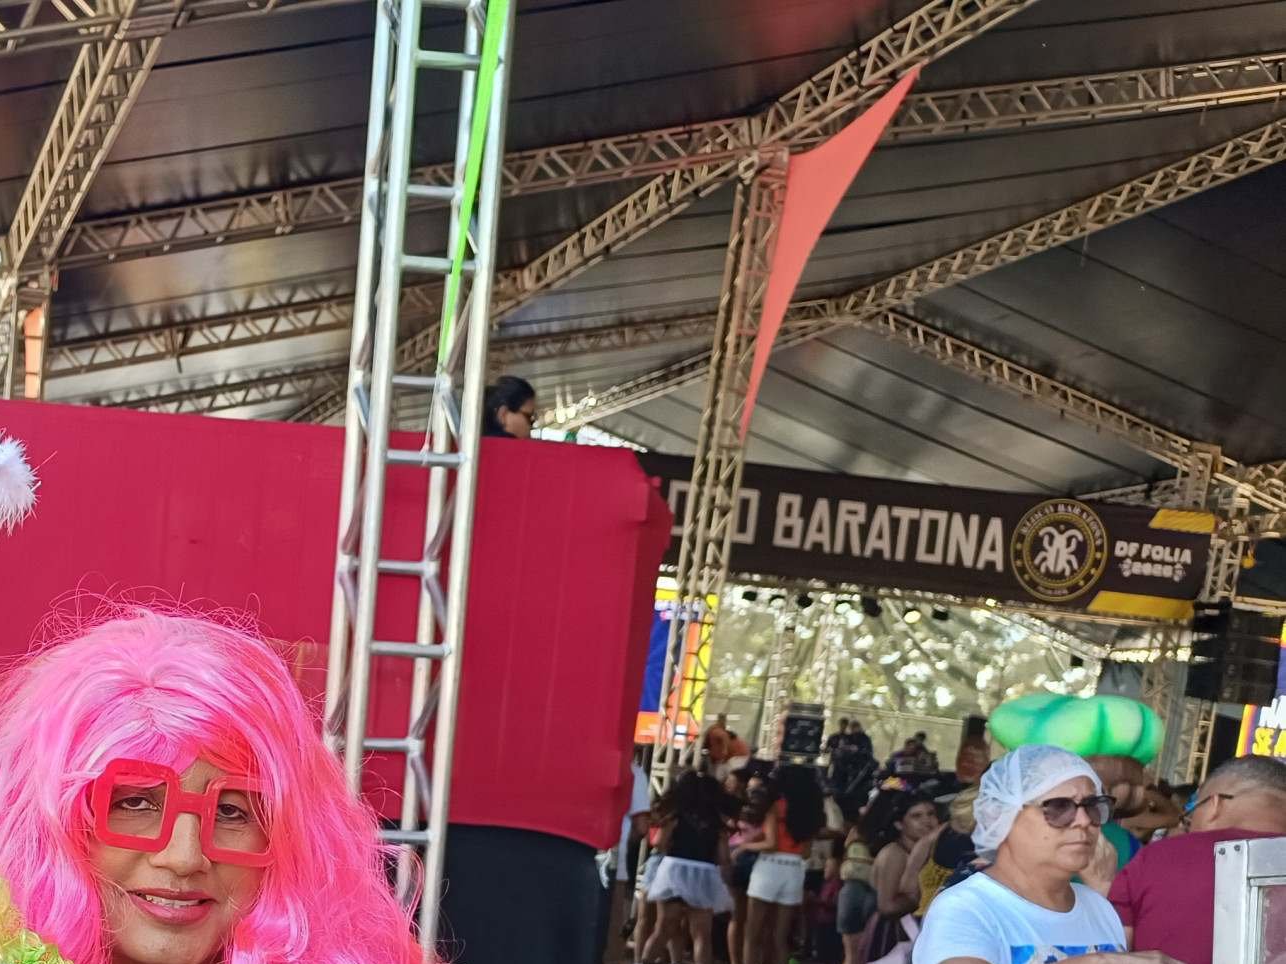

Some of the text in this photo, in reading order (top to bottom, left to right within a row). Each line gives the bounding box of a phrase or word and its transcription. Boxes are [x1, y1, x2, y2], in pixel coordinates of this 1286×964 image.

[772, 492, 1005, 573] BARATONA
[1114, 540, 1192, 565] DF FOLIA
